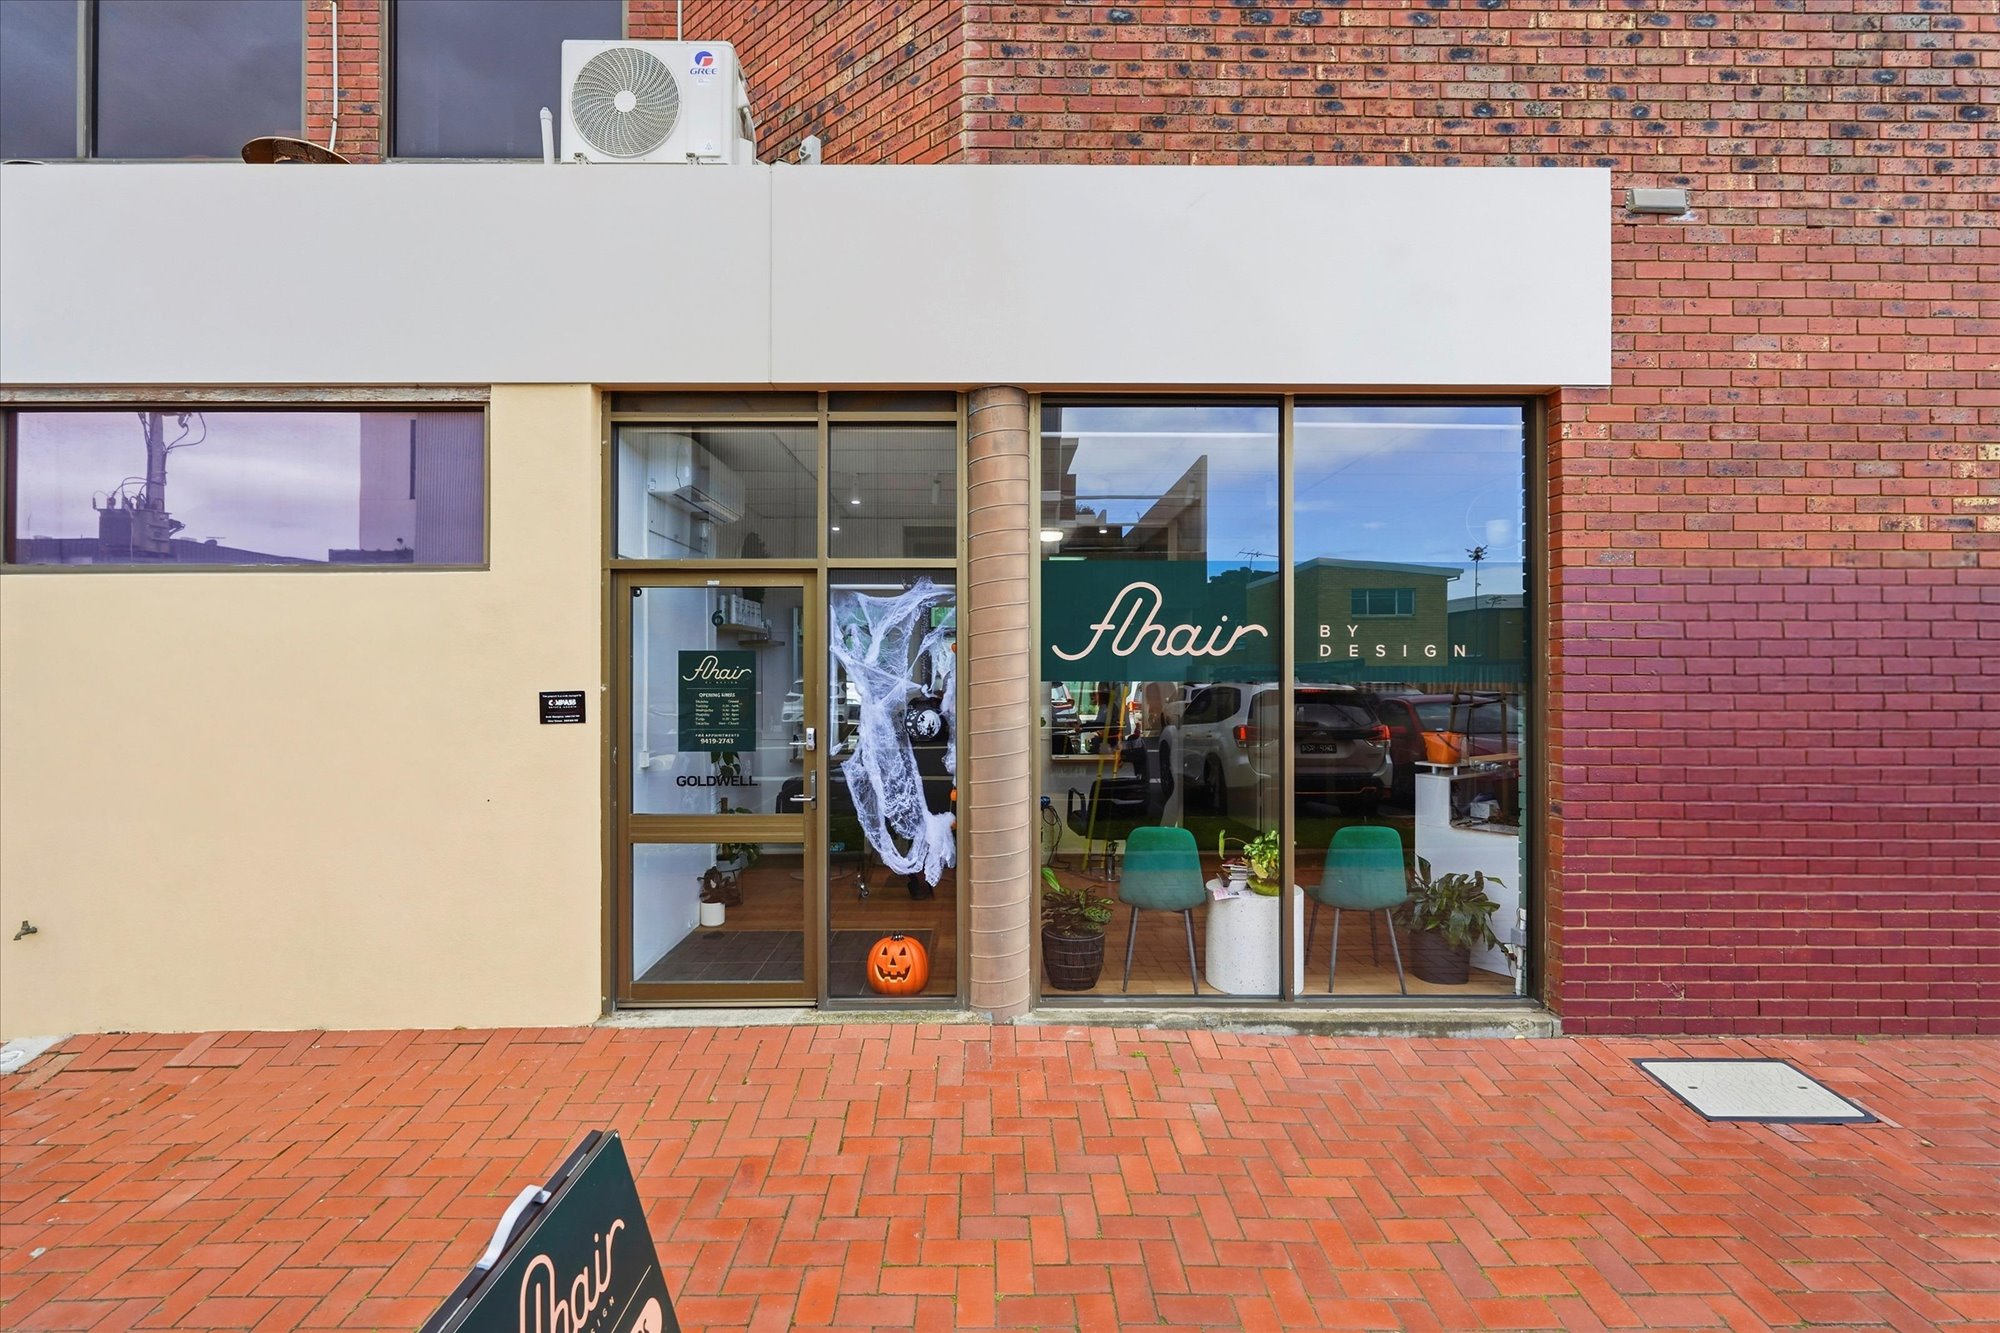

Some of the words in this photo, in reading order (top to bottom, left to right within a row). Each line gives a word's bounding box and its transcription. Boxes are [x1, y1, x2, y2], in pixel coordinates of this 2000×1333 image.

[712, 610, 724, 627] 6
[1319, 624, 1358, 638] BY
[1319, 644, 1466, 657] DESIGN
[676, 775, 758, 787] GOLDWELL
